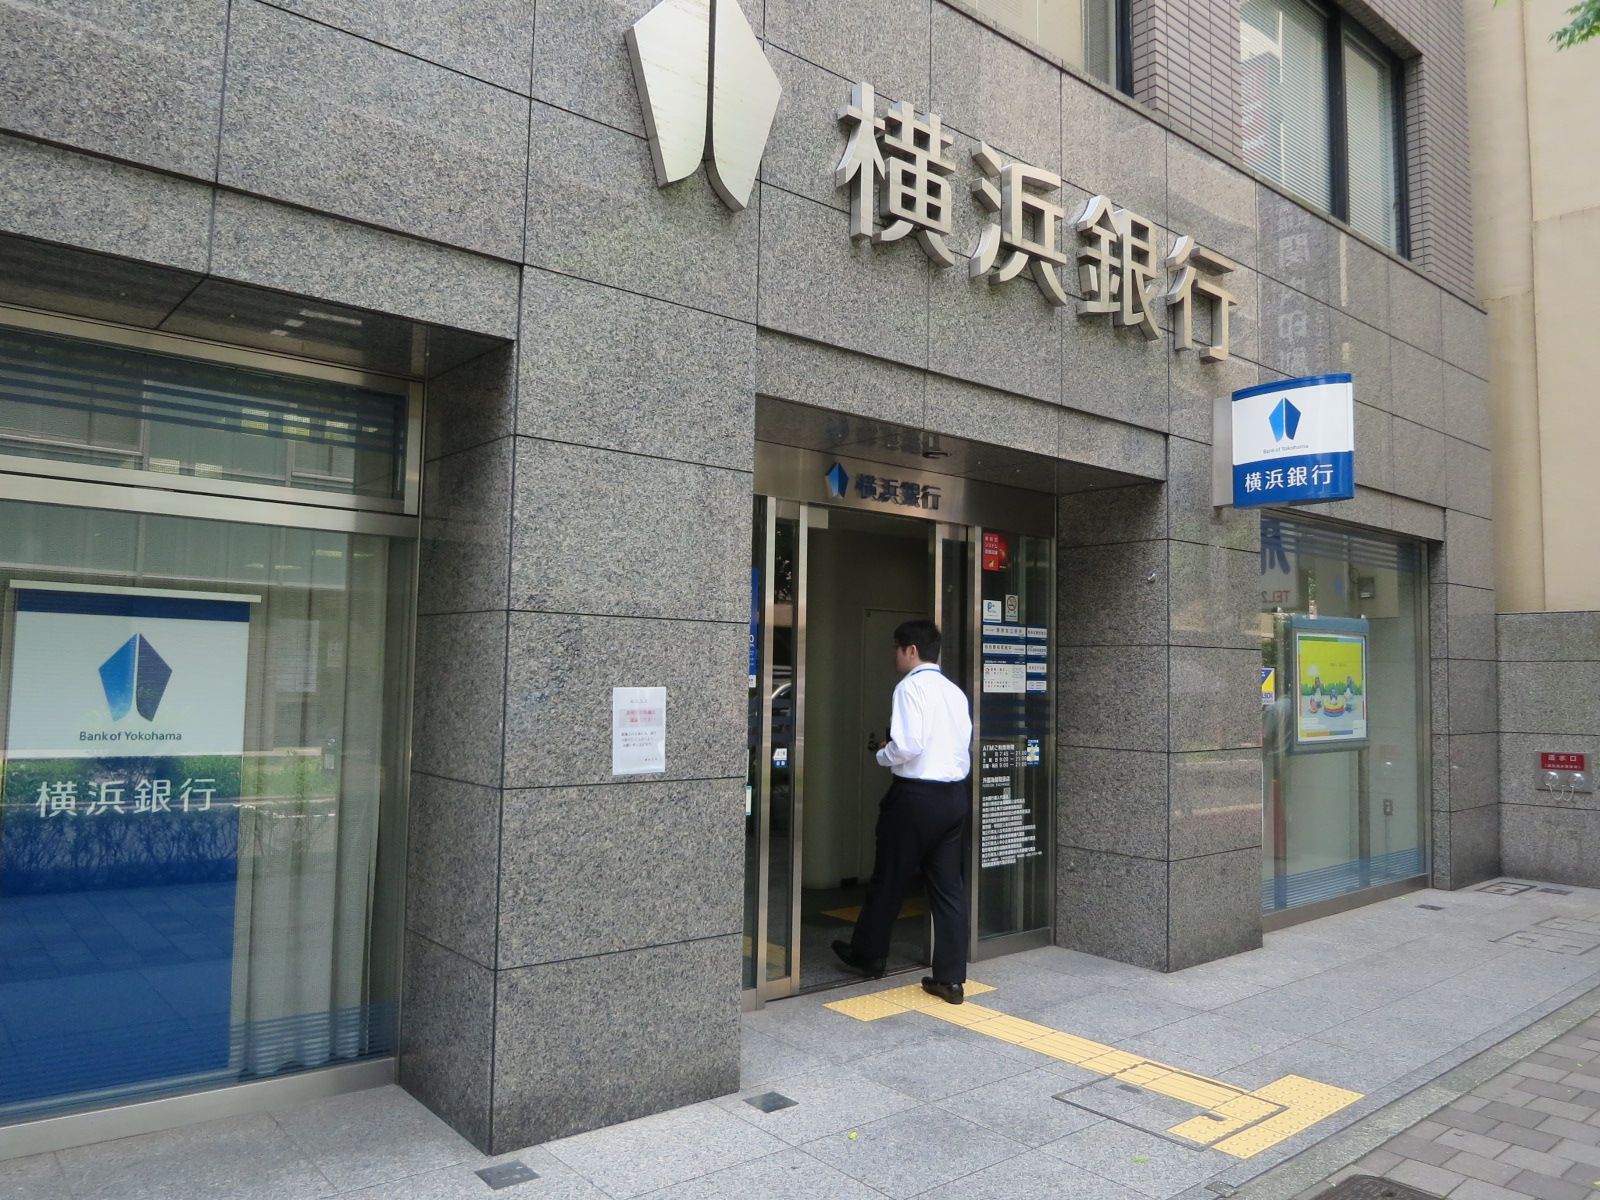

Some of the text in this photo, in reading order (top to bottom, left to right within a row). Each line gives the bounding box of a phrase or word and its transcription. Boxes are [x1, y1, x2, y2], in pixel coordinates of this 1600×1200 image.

[836, 81, 1238, 363] 横浜銀行
[855, 473, 942, 511] 横浜銀行
[1244, 464, 1334, 493] 横浜銀行
[79, 731, 182, 741] Bank of Yokohama
[36, 778, 217, 818] 横浜銀行
